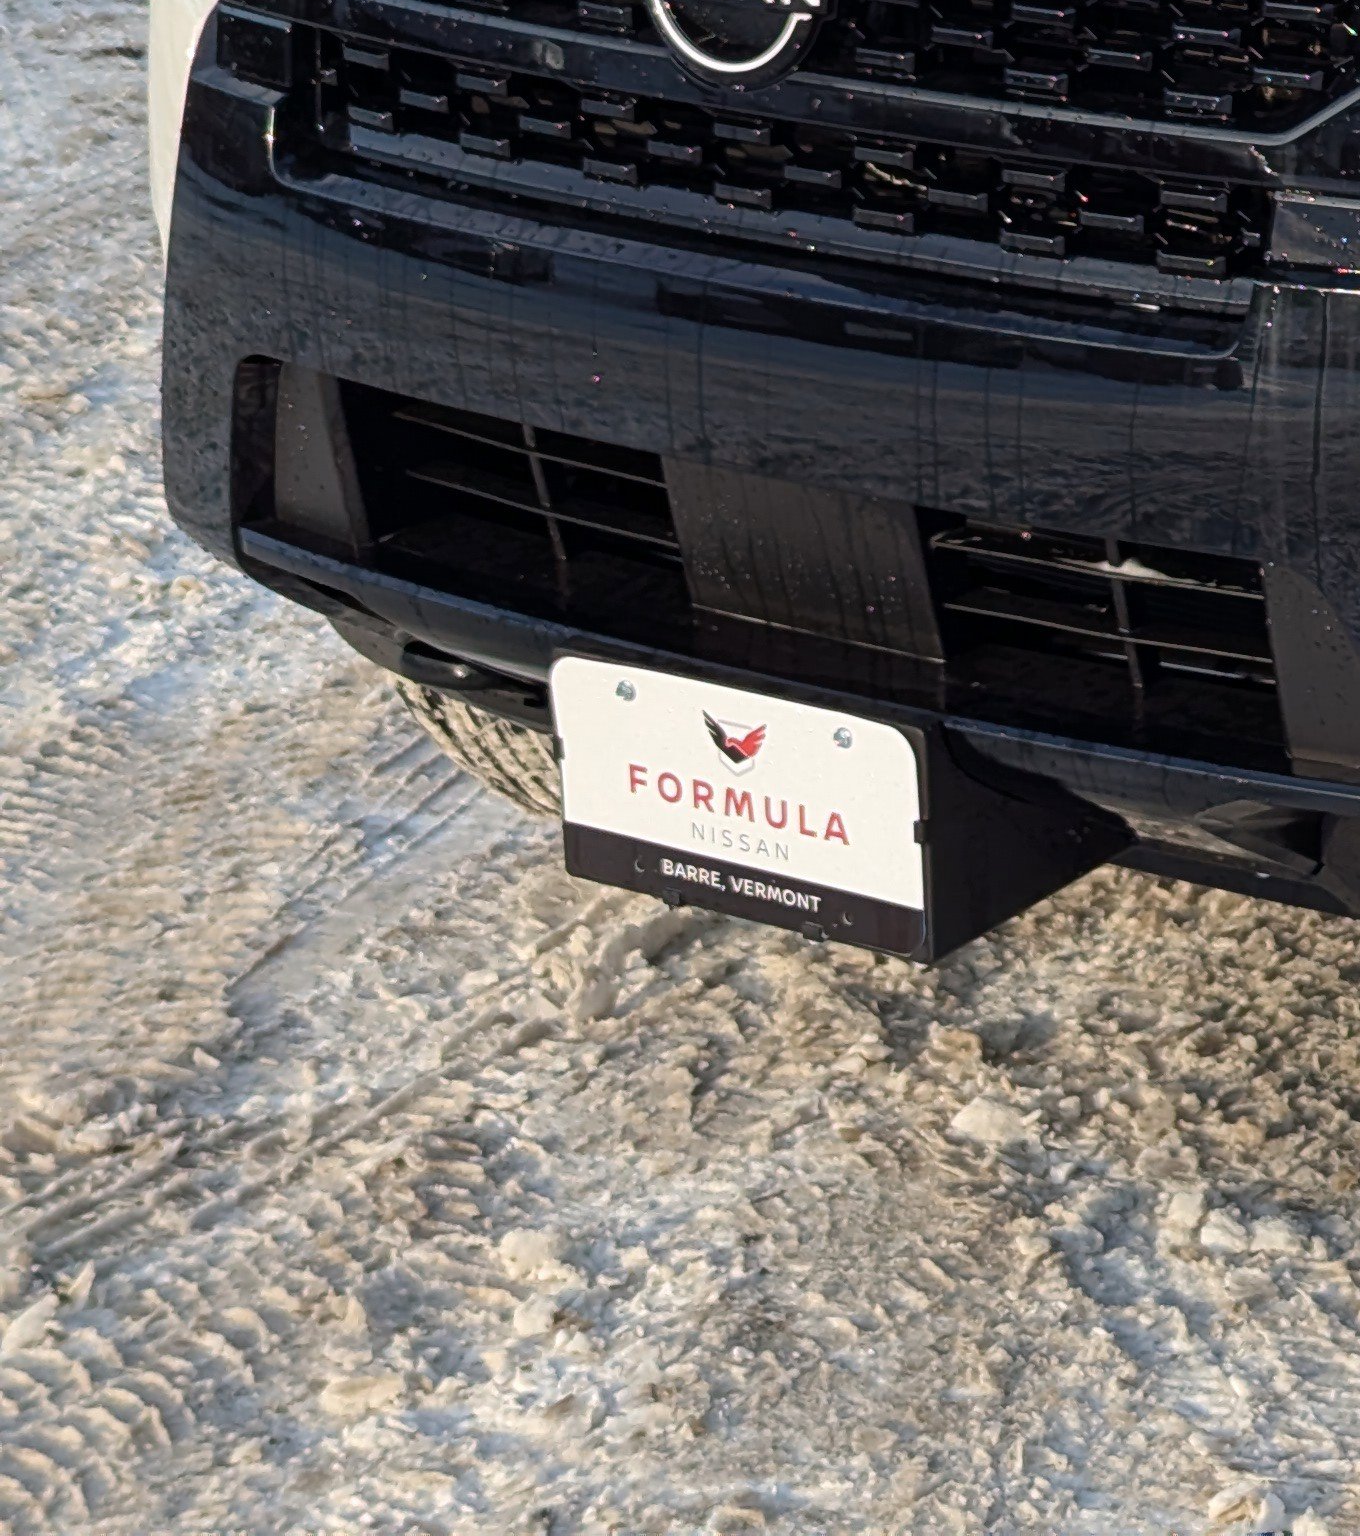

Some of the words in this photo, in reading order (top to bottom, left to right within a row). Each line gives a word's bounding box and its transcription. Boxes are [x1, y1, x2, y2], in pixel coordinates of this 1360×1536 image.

[628, 763, 850, 846] FORMULA
[691, 822, 790, 861] NISSAN
[661, 858, 726, 892] BARRE,
[728, 875, 821, 913] VERMONT
